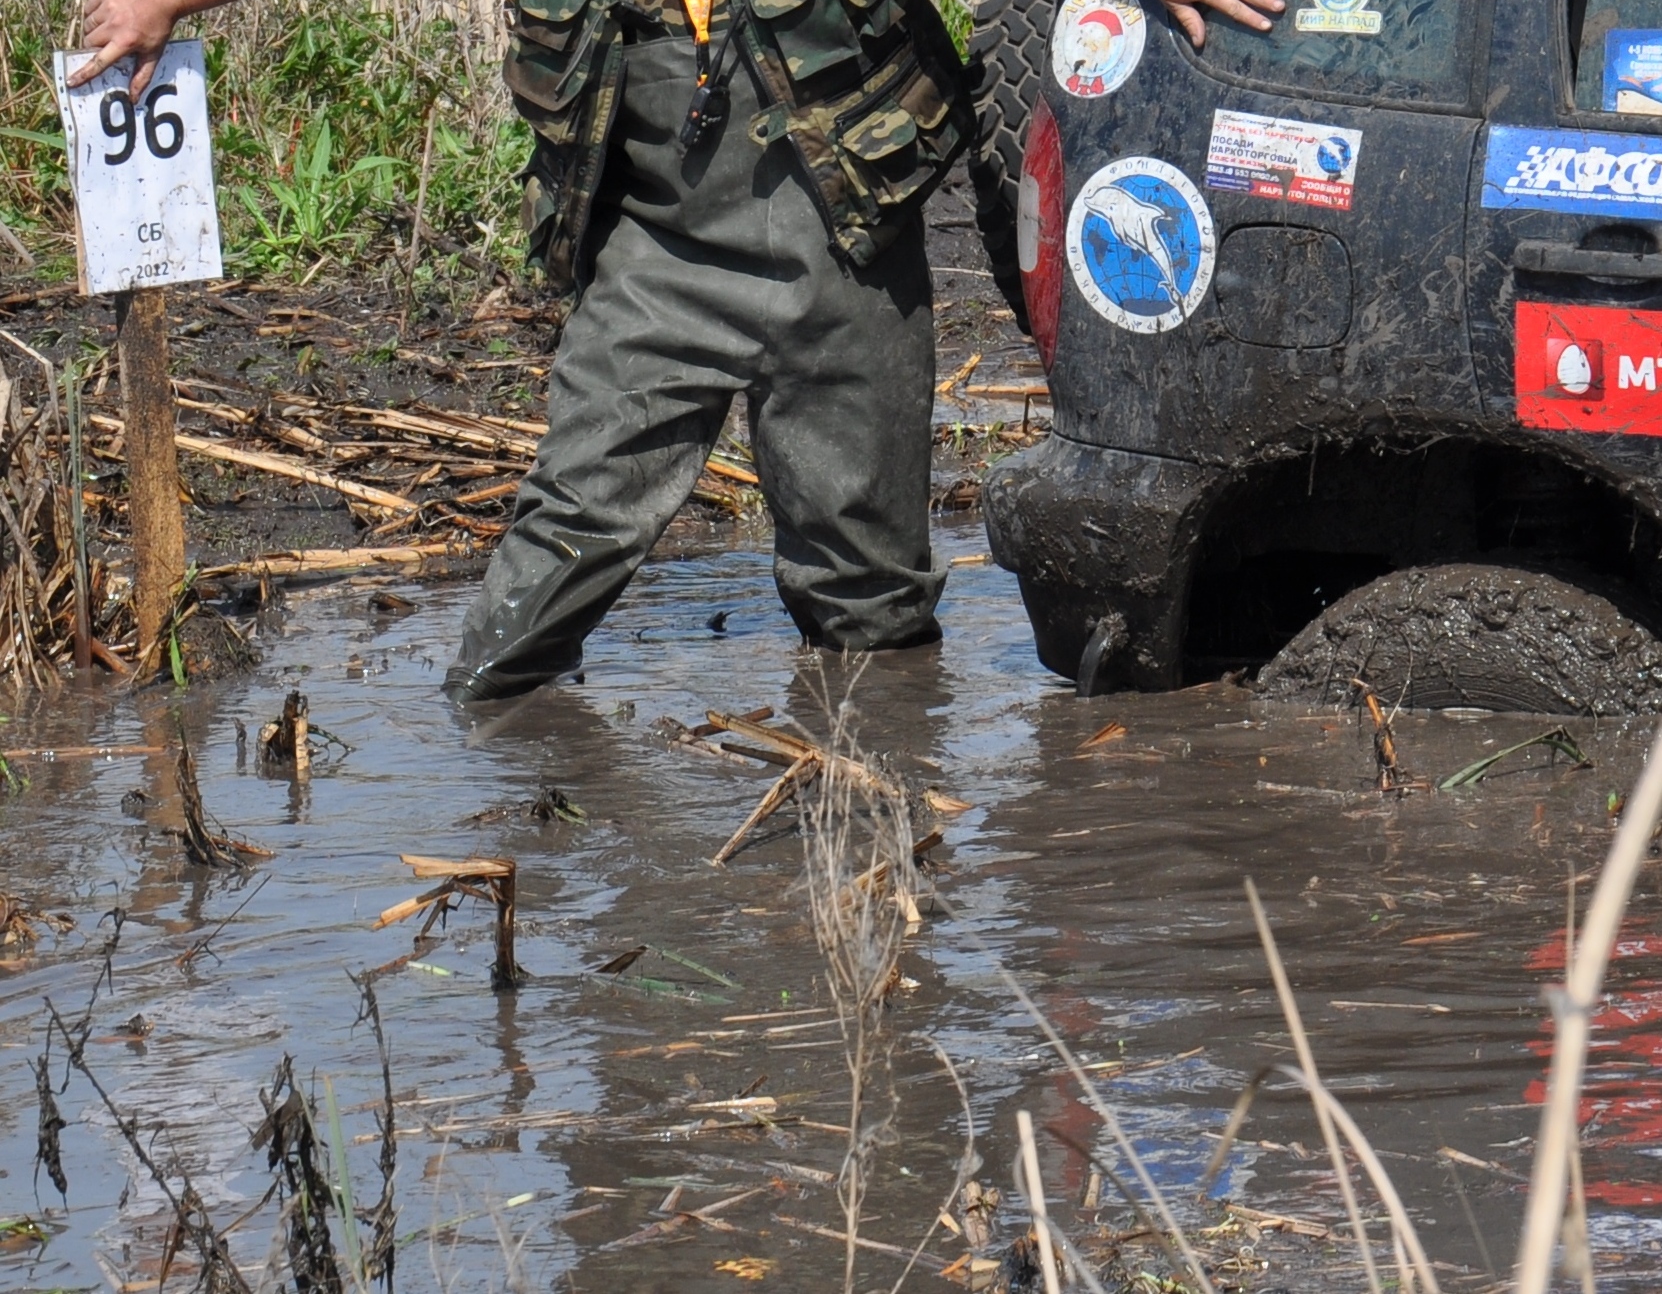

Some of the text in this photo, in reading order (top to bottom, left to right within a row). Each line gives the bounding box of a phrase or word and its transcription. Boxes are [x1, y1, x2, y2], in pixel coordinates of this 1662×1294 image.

[1299, 14, 1376, 28] МИР НАГРАД
[100, 84, 185, 166] 96
[1212, 135, 1254, 148] ПОСАДИ
[1211, 145, 1298, 165] НАРКОТОРГОВЦА
[1109, 159, 1165, 175] ФОНД
[138, 222, 162, 243] СБ
[136, 261, 169, 280] 2012
